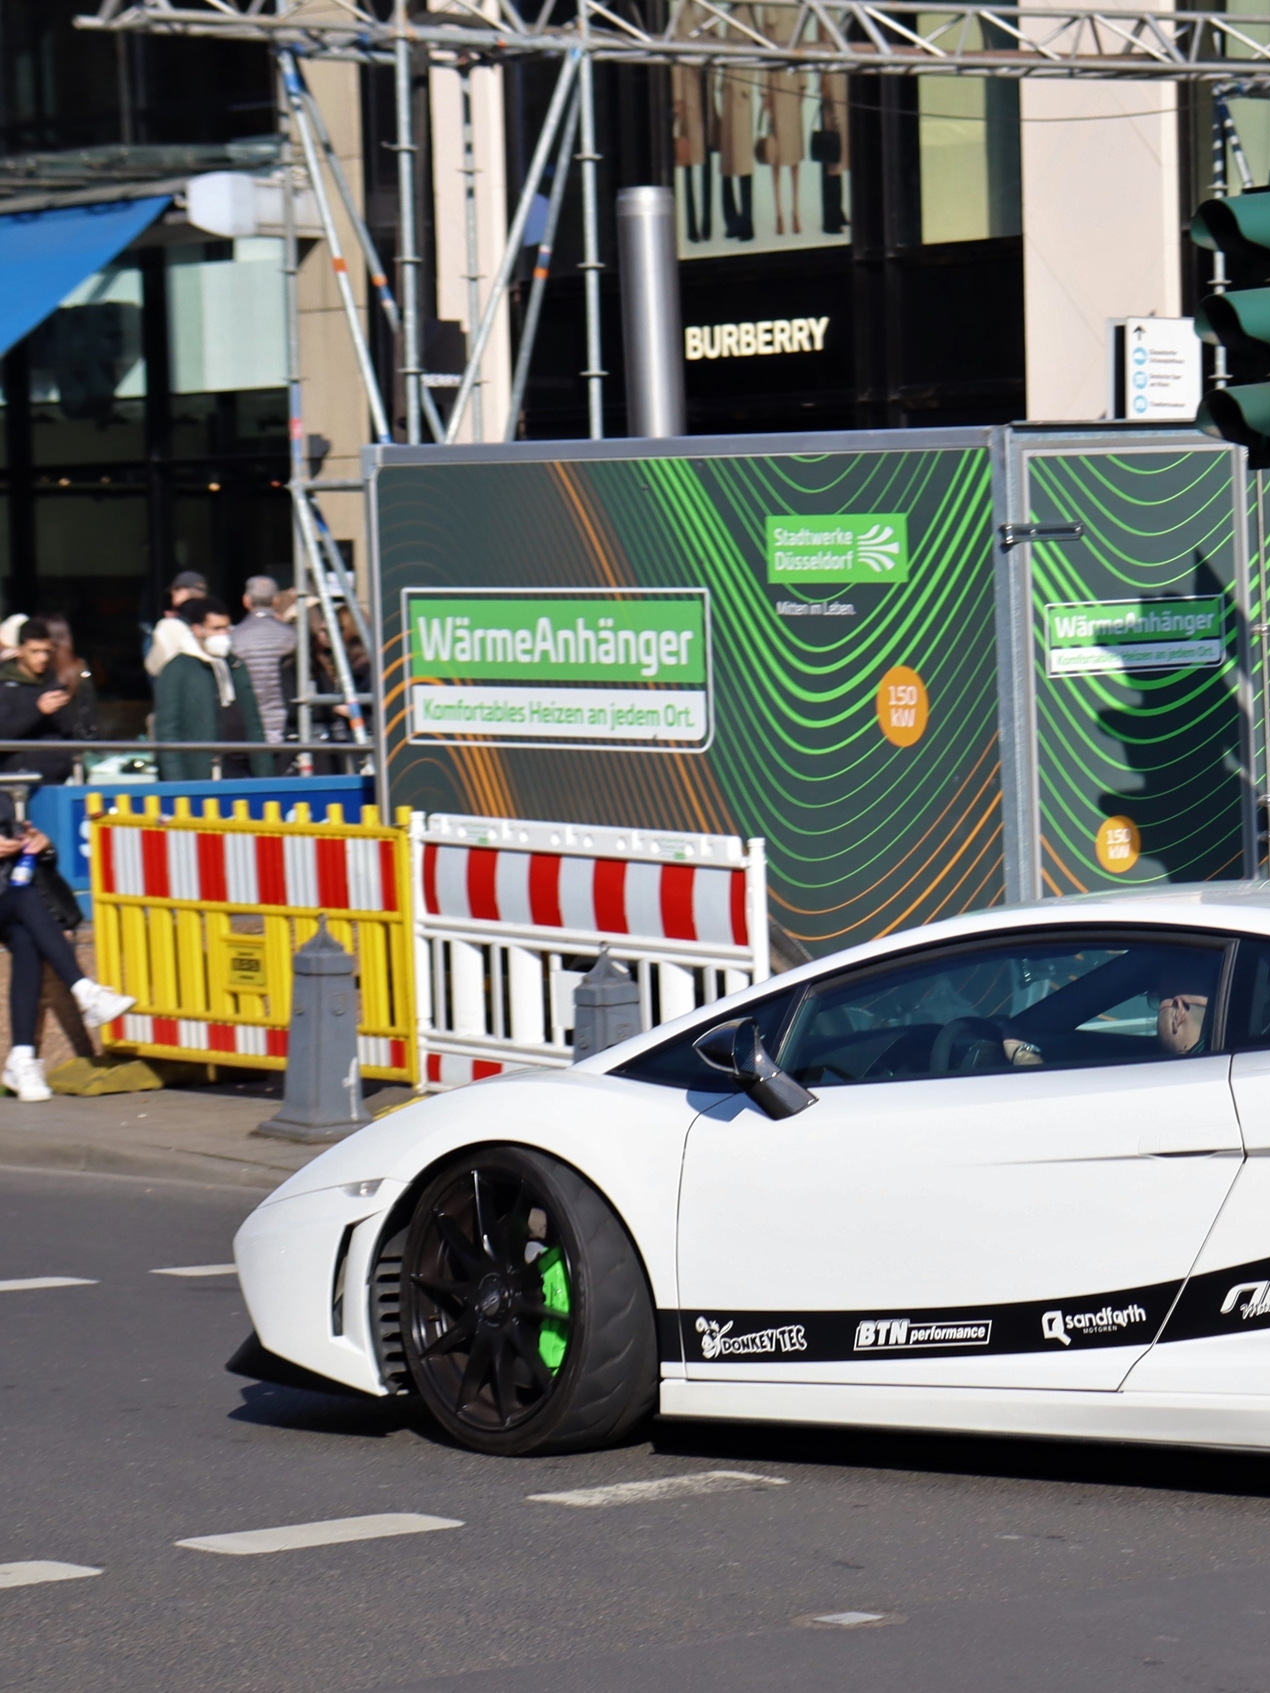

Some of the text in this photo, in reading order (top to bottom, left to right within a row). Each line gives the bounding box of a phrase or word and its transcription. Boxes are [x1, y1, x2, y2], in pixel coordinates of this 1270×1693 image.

[685, 316, 830, 360] BURBERRY
[773, 526, 853, 547] Stadtwerke
[774, 550, 854, 571] Düsseldorf
[776, 601, 808, 615] Mitten
[1054, 610, 1215, 639] WärmeAnhänger
[417, 616, 694, 677] WärmeAnhänger
[888, 685, 918, 706] 150
[423, 697, 696, 731] Komfortables Heizen an jedem Ort.
[890, 707, 917, 728] kW
[1106, 828, 1131, 844] 150
[1108, 844, 1130, 859] kW
[720, 1324, 808, 1354] DONKEY TEC
[857, 1318, 986, 1347] BTN performance
[1082, 1325, 1118, 1334] MOTOREN
